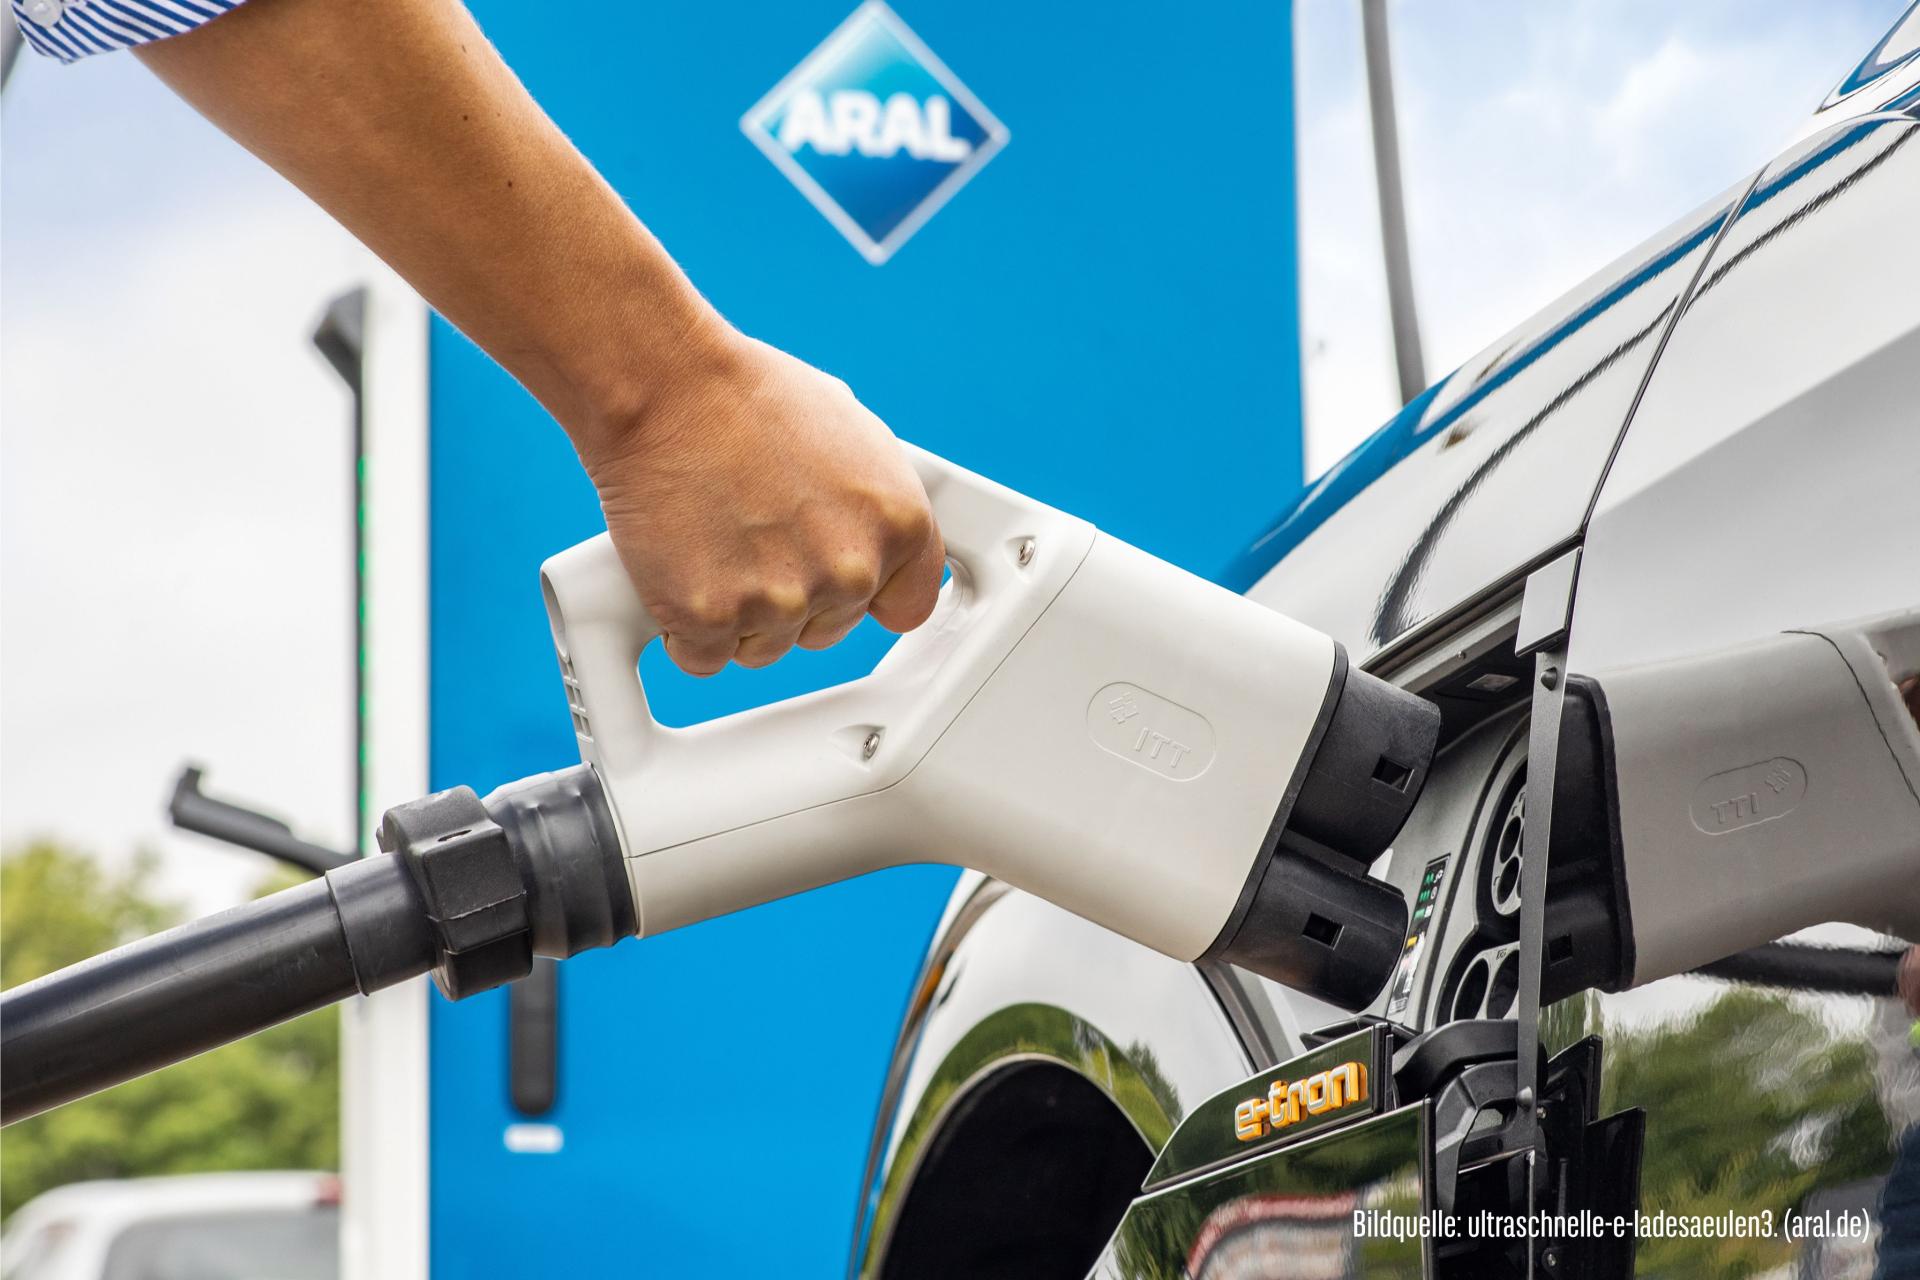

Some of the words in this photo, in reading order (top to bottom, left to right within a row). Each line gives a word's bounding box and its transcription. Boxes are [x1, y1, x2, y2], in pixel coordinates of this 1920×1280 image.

[781, 89, 971, 162] ARAL
[1134, 726, 1192, 769] ITT
[1234, 1061, 1369, 1142] e-tron
